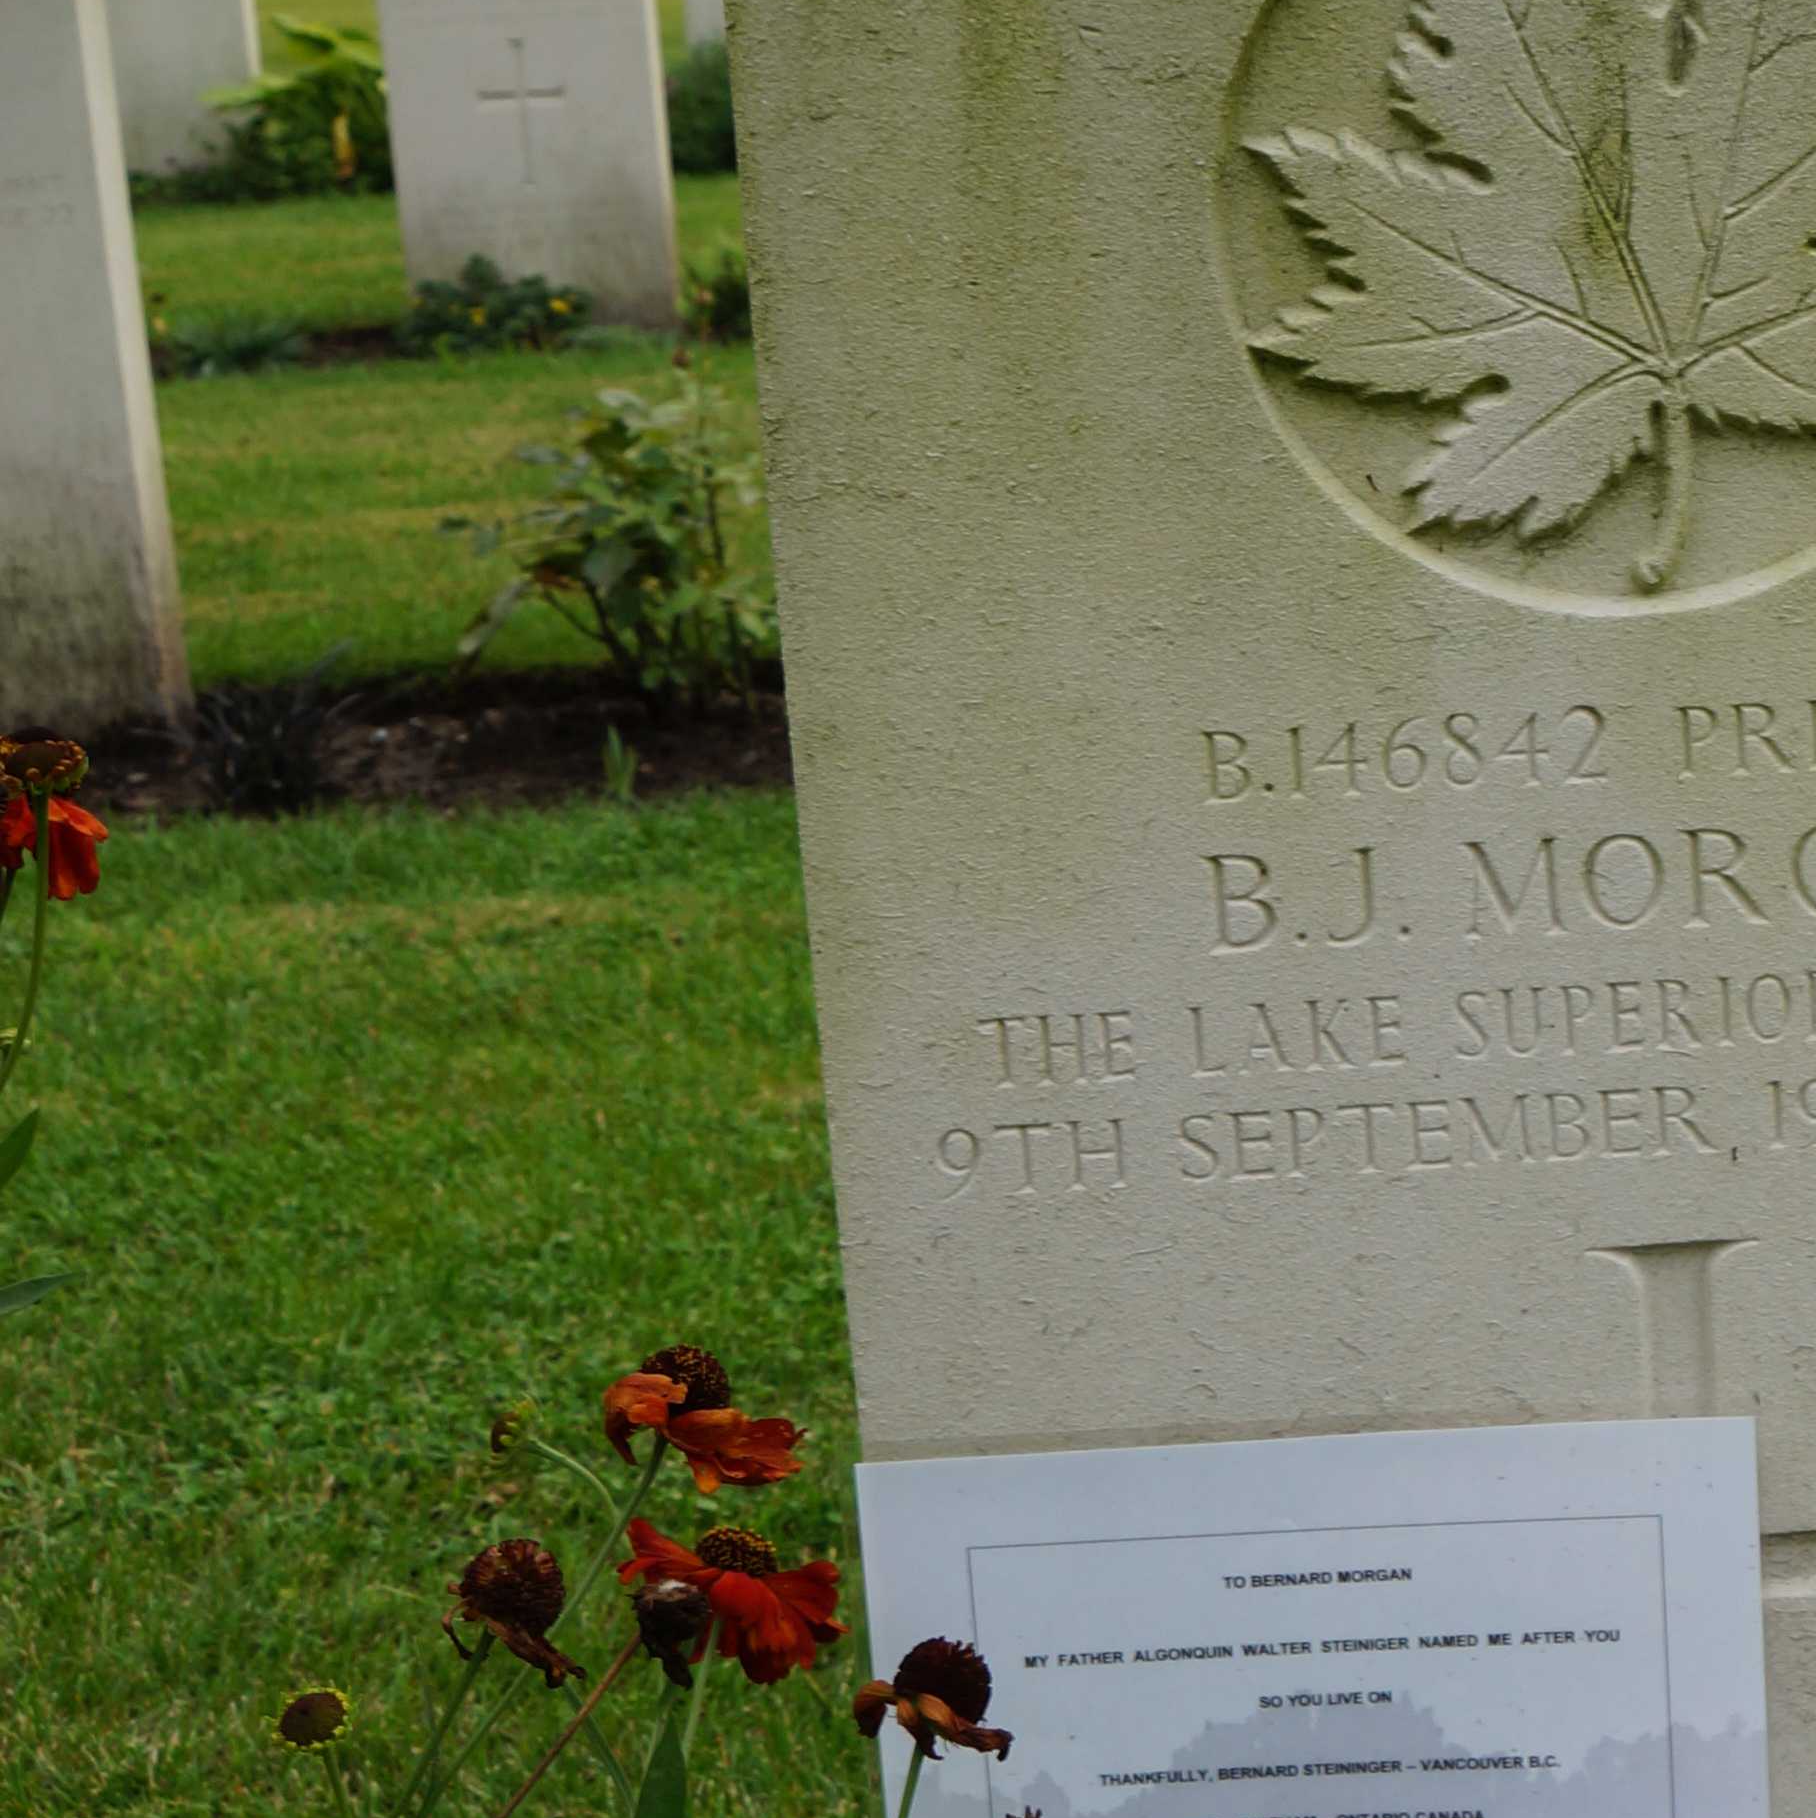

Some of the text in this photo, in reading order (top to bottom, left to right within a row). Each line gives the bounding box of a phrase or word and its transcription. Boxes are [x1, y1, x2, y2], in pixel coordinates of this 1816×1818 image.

[1200, 703, 1608, 805] B.146842
[976, 1010, 1136, 1089] THE
[1187, 994, 1408, 1080] LAKE
[936, 1117, 1128, 1203] 9TH
[1222, 1567, 1413, 1590] TO BERNARD MORGAN
[1023, 1628, 1621, 1669] MY FATHER ALGONQUIN WALTER STEINIGER NAMED ME AFTER YOU
[1259, 1689, 1392, 1709] SO YOU LIVE ON
[1099, 1767, 1213, 1786] THANKFULLY,
[1217, 1763, 1300, 1781] BERNARD
[1302, 1759, 1403, 1777] STEININGER
[1419, 1755, 1524, 1773] VANCOUVER
[1528, 1753, 1561, 1769] B.C.
